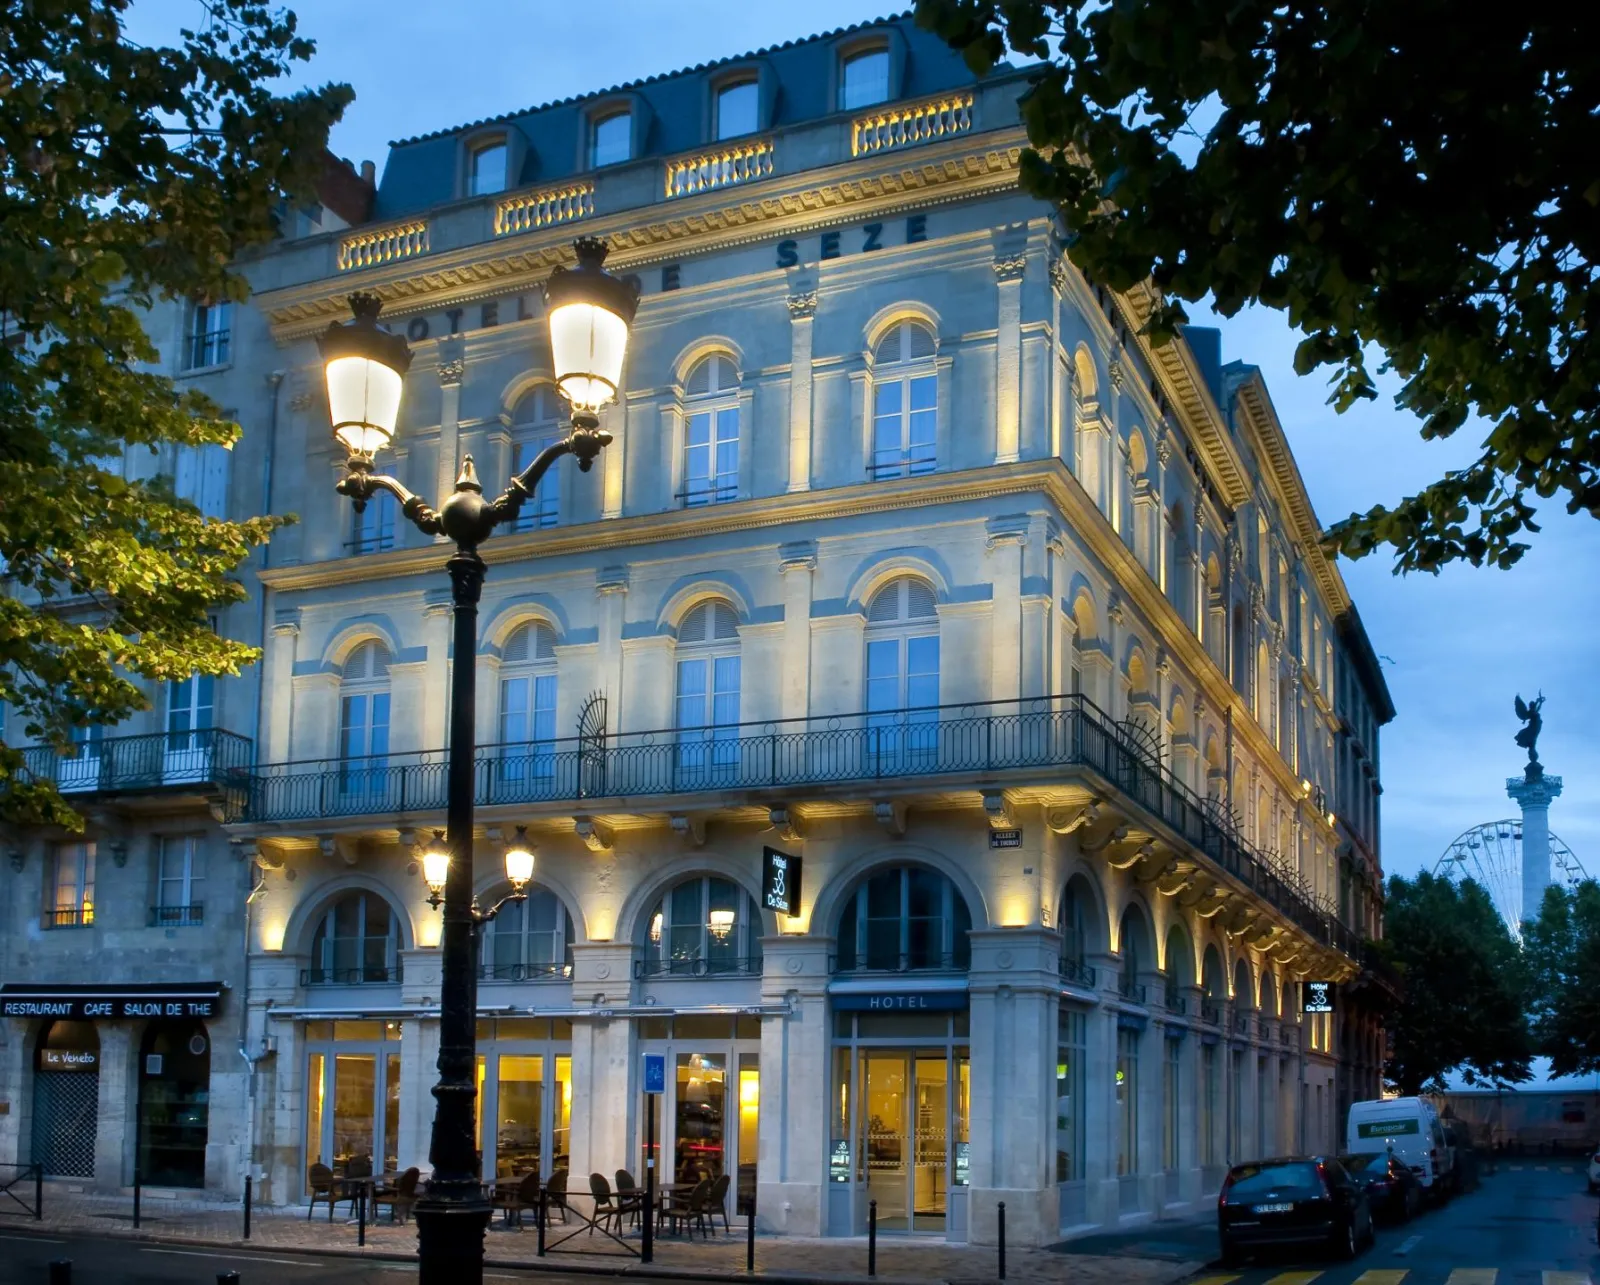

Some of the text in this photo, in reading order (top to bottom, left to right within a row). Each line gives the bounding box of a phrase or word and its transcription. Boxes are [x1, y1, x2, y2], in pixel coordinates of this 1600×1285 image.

[383, 295, 534, 342] OTEL
[775, 213, 929, 269] SEZE
[4, 1001, 212, 1016] RESTAURANT CAFE SALON DE THE
[869, 996, 928, 1009] HOTEL
[47, 1050, 95, 1064] Le Veneto
